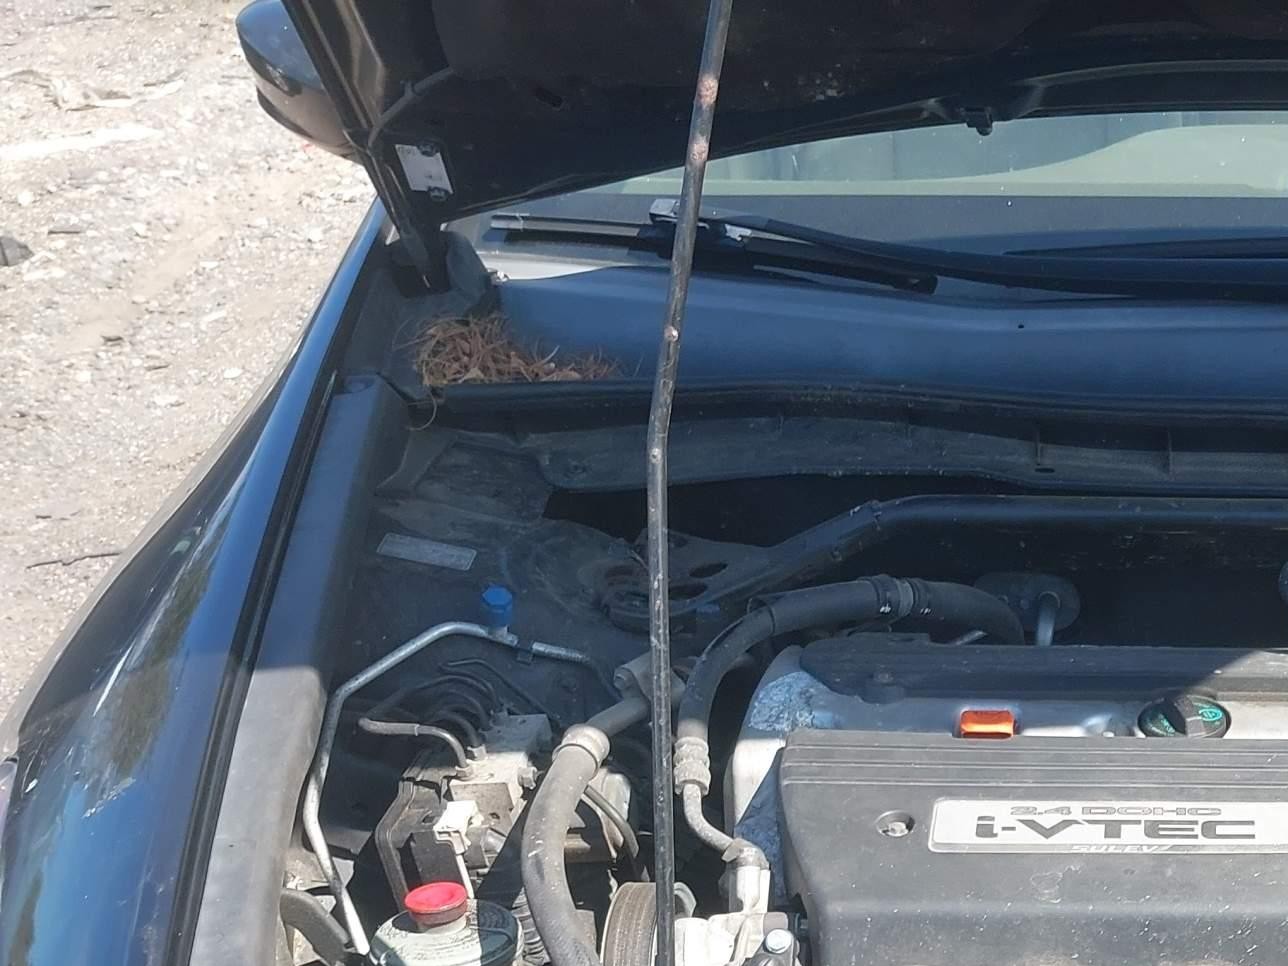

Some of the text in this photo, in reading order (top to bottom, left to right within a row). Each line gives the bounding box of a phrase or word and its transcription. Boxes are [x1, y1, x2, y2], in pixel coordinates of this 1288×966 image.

[1010, 806, 1222, 817] 2.4 DOHC
[975, 816, 1256, 840] i-VTEC
